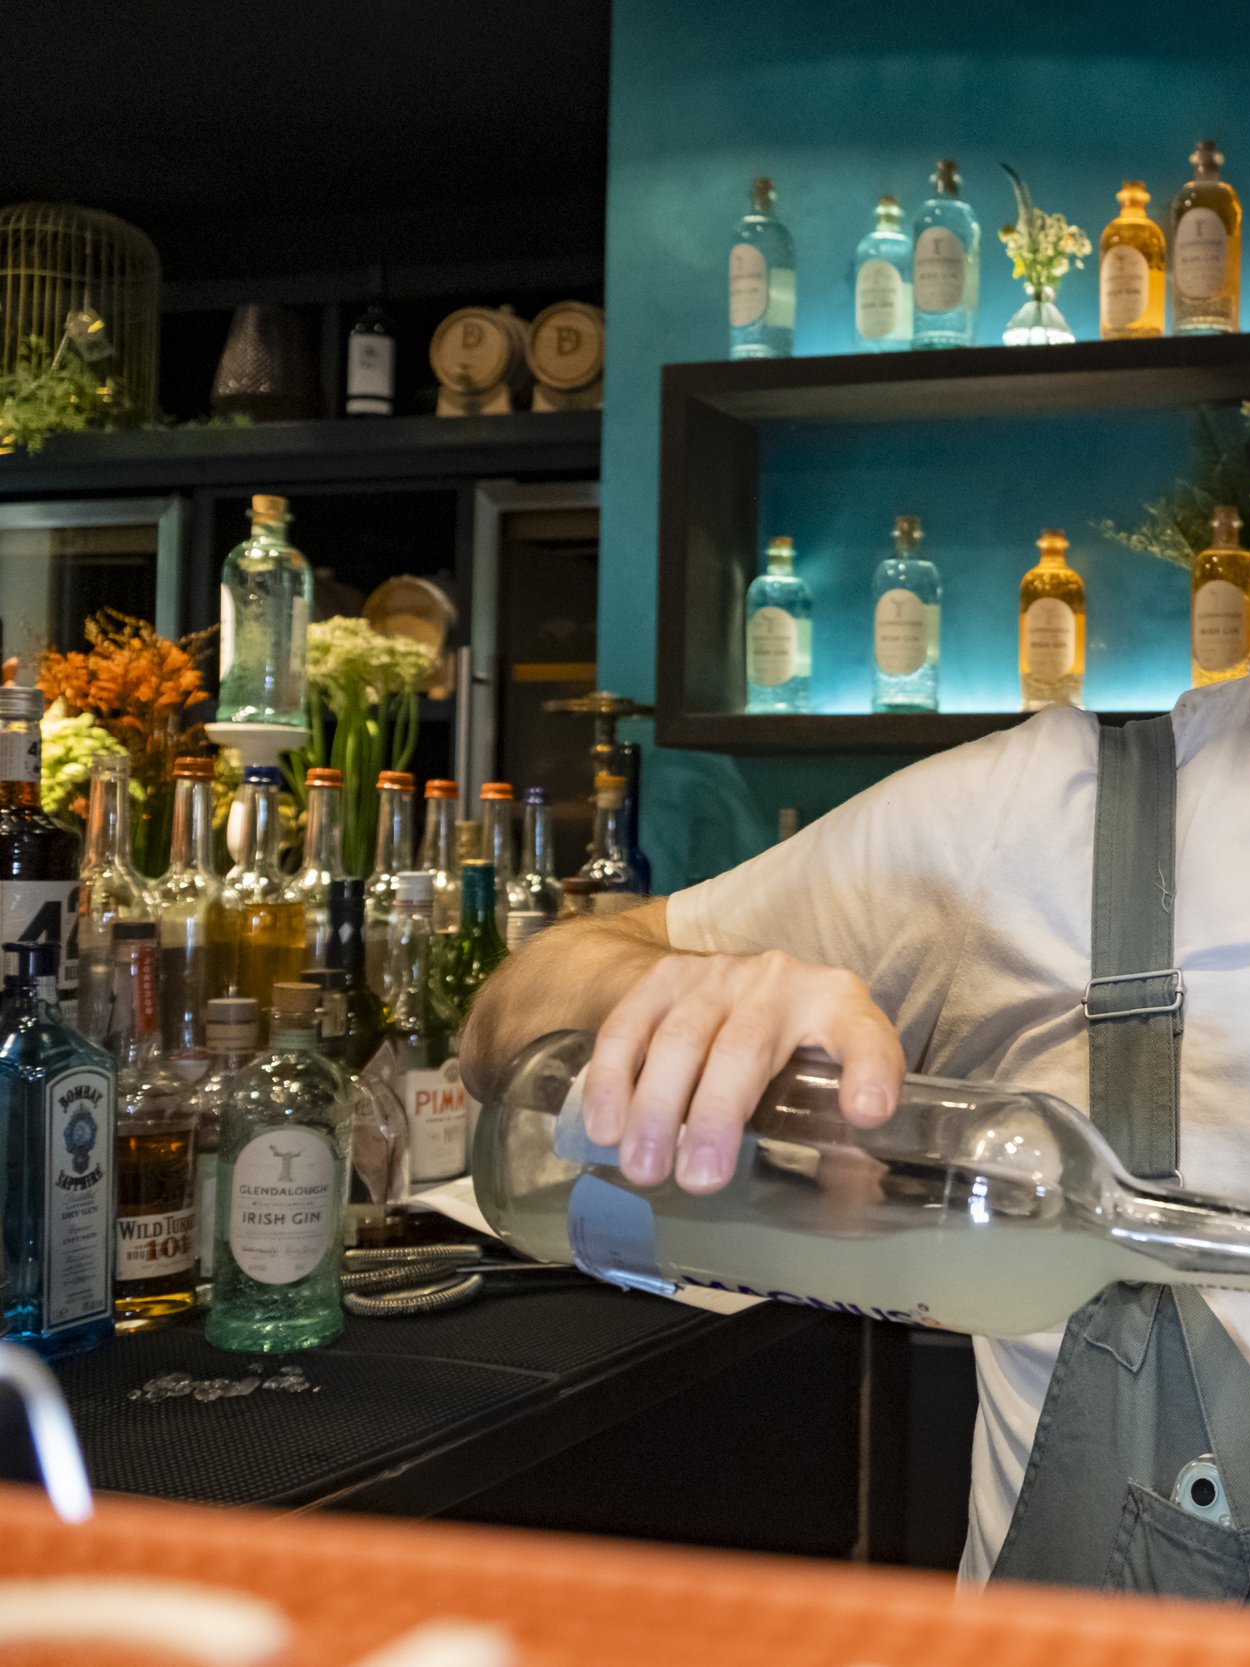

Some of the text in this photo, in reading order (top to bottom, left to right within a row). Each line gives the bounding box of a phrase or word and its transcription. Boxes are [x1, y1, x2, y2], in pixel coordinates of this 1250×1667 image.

[58, 1085, 103, 1113] BOMBAY
[239, 1184, 328, 1196] GLENDALOUGH
[242, 1211, 321, 1226] IRISH GIN
[119, 1219, 163, 1241] WILD
